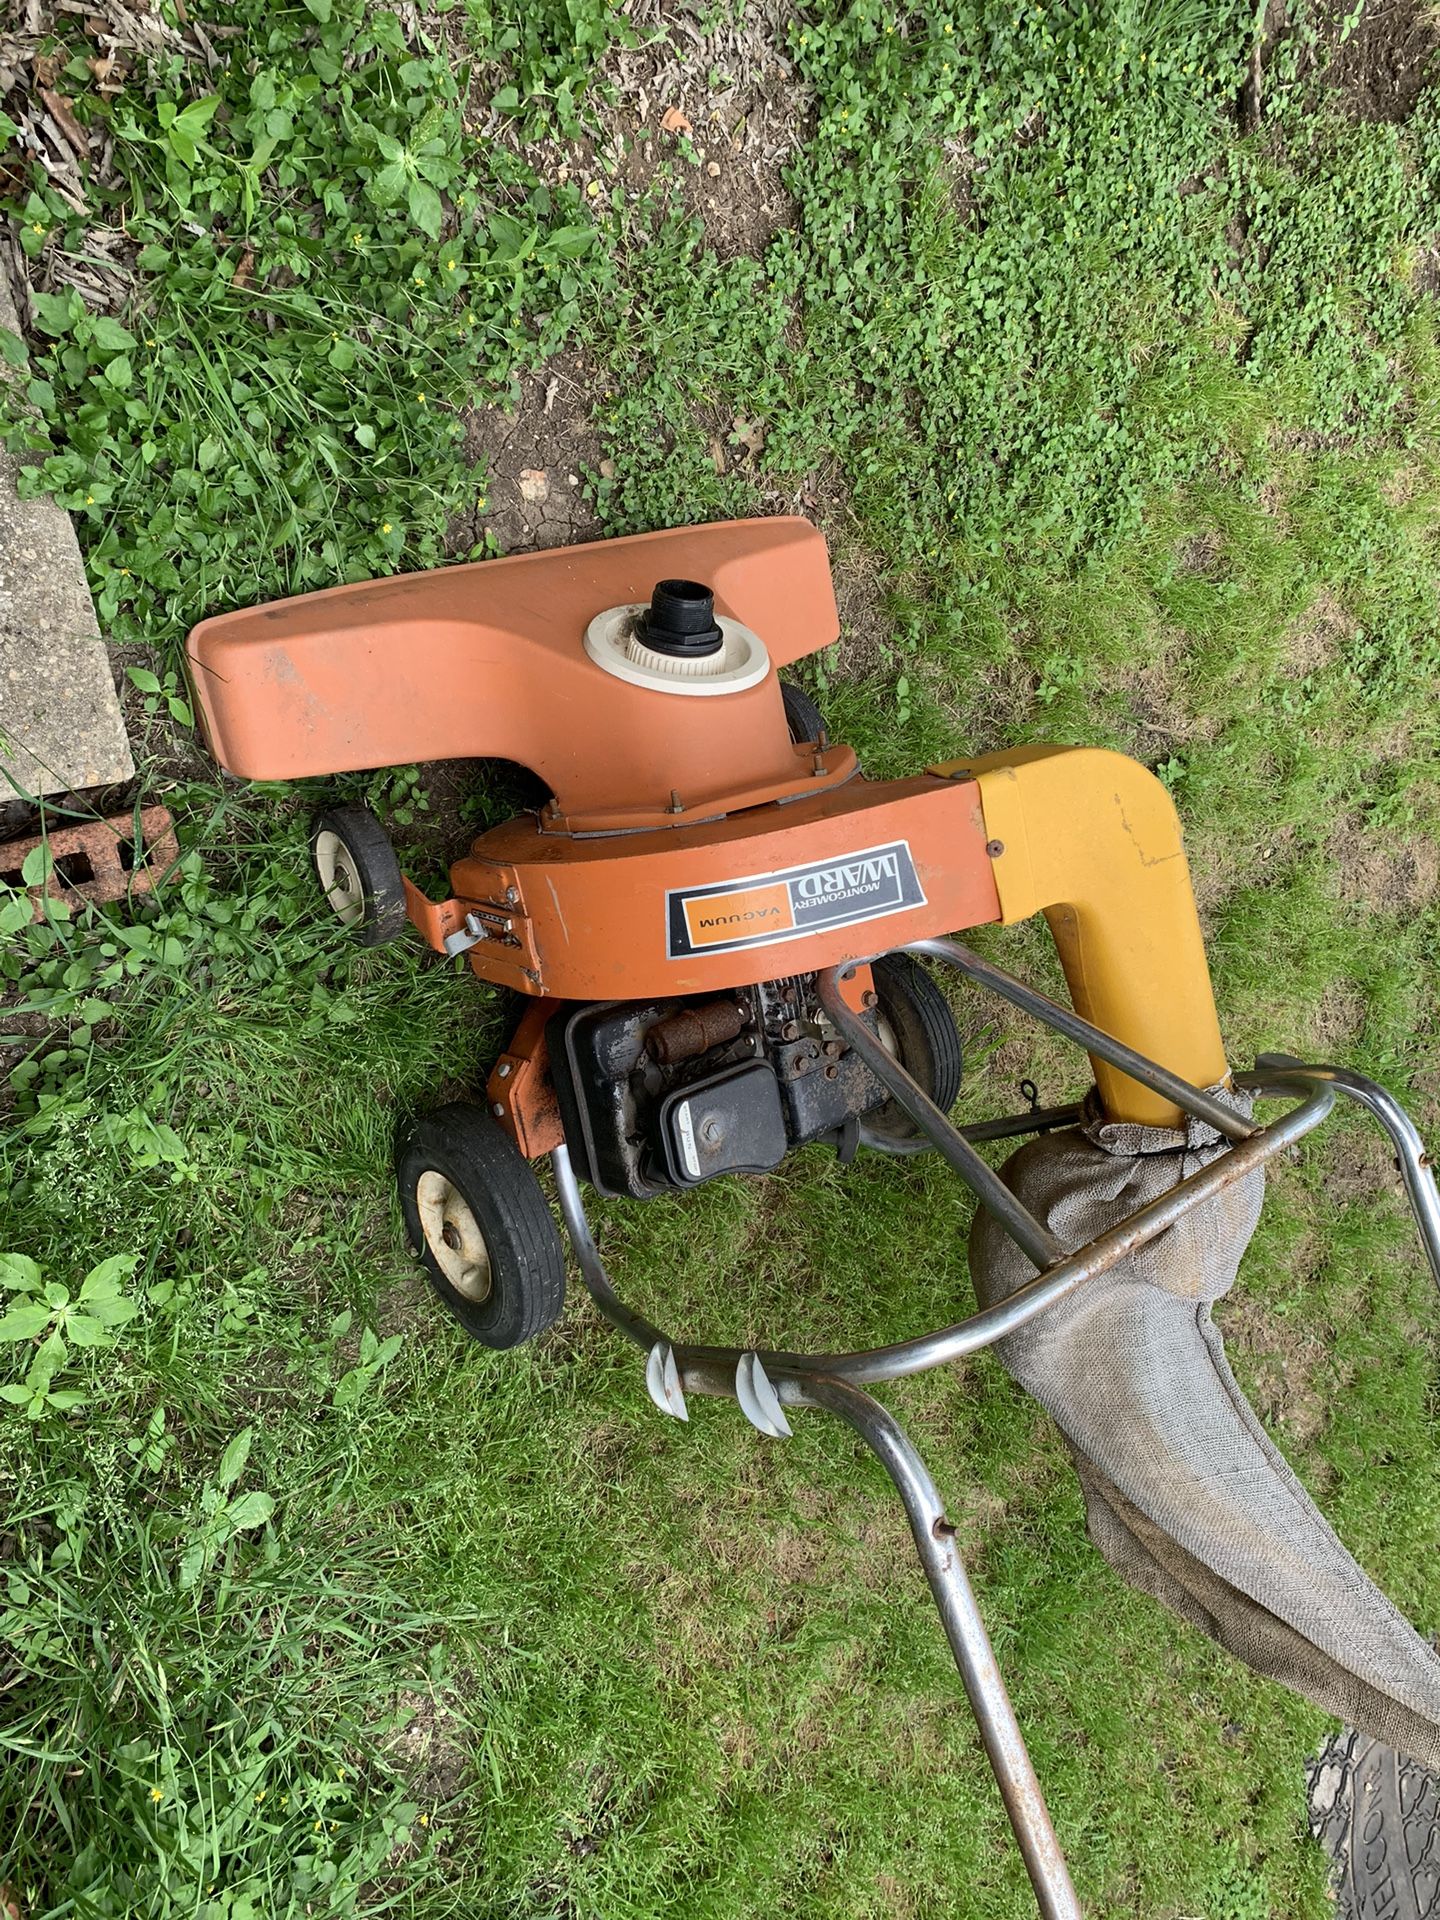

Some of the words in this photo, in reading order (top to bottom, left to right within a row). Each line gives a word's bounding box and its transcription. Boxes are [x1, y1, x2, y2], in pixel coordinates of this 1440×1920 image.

[793, 880, 881, 911] MONTGOMERY
[798, 855, 897, 899] WARD
[699, 907, 781, 928] VACUUM
[1363, 1753, 1399, 1920] ELCOME
